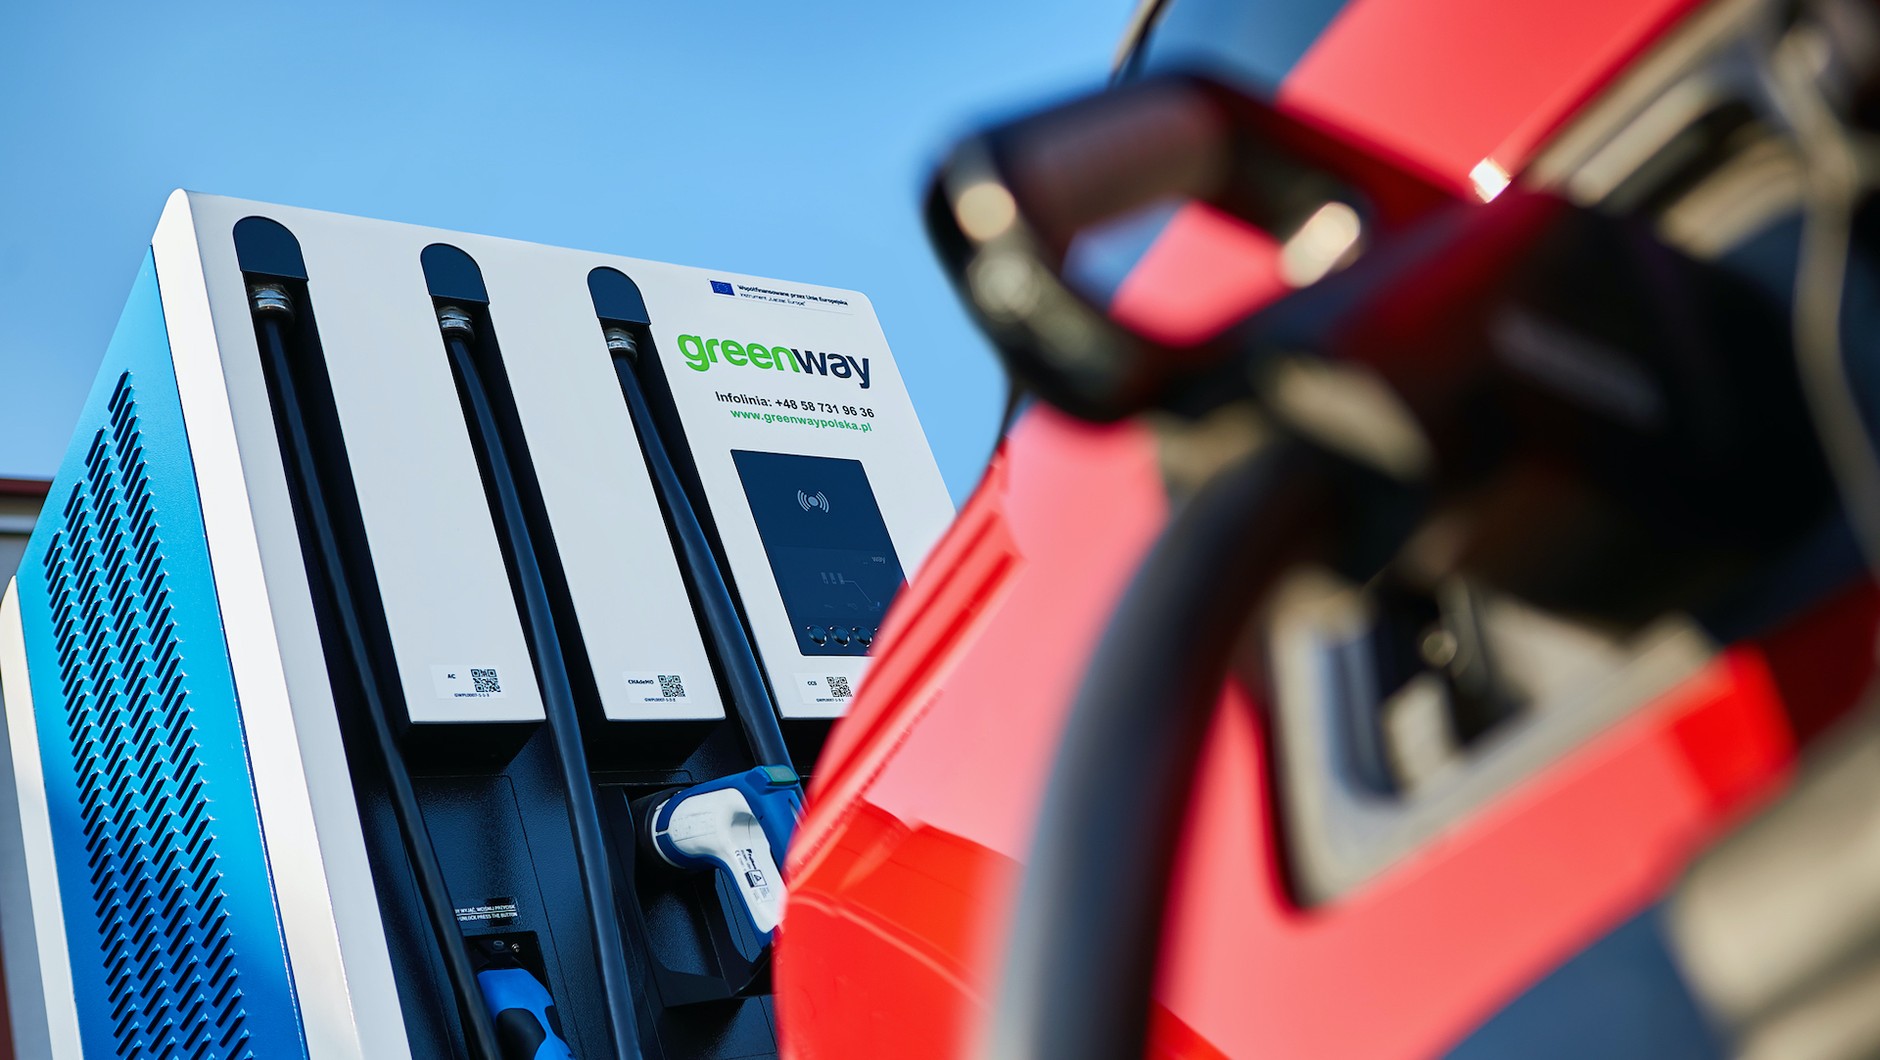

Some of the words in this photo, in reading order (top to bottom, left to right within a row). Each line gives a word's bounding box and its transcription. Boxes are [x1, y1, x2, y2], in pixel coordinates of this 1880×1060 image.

[677, 334, 870, 389] greenway
[715, 391, 772, 407] Infolinia:
[775, 399, 798, 410] +48
[801, 401, 815, 412] 58
[817, 402, 840, 414] 731
[842, 405, 857, 416] 96
[859, 407, 875, 418] 36
[730, 409, 872, 433] www.greenwaypolska.pl
